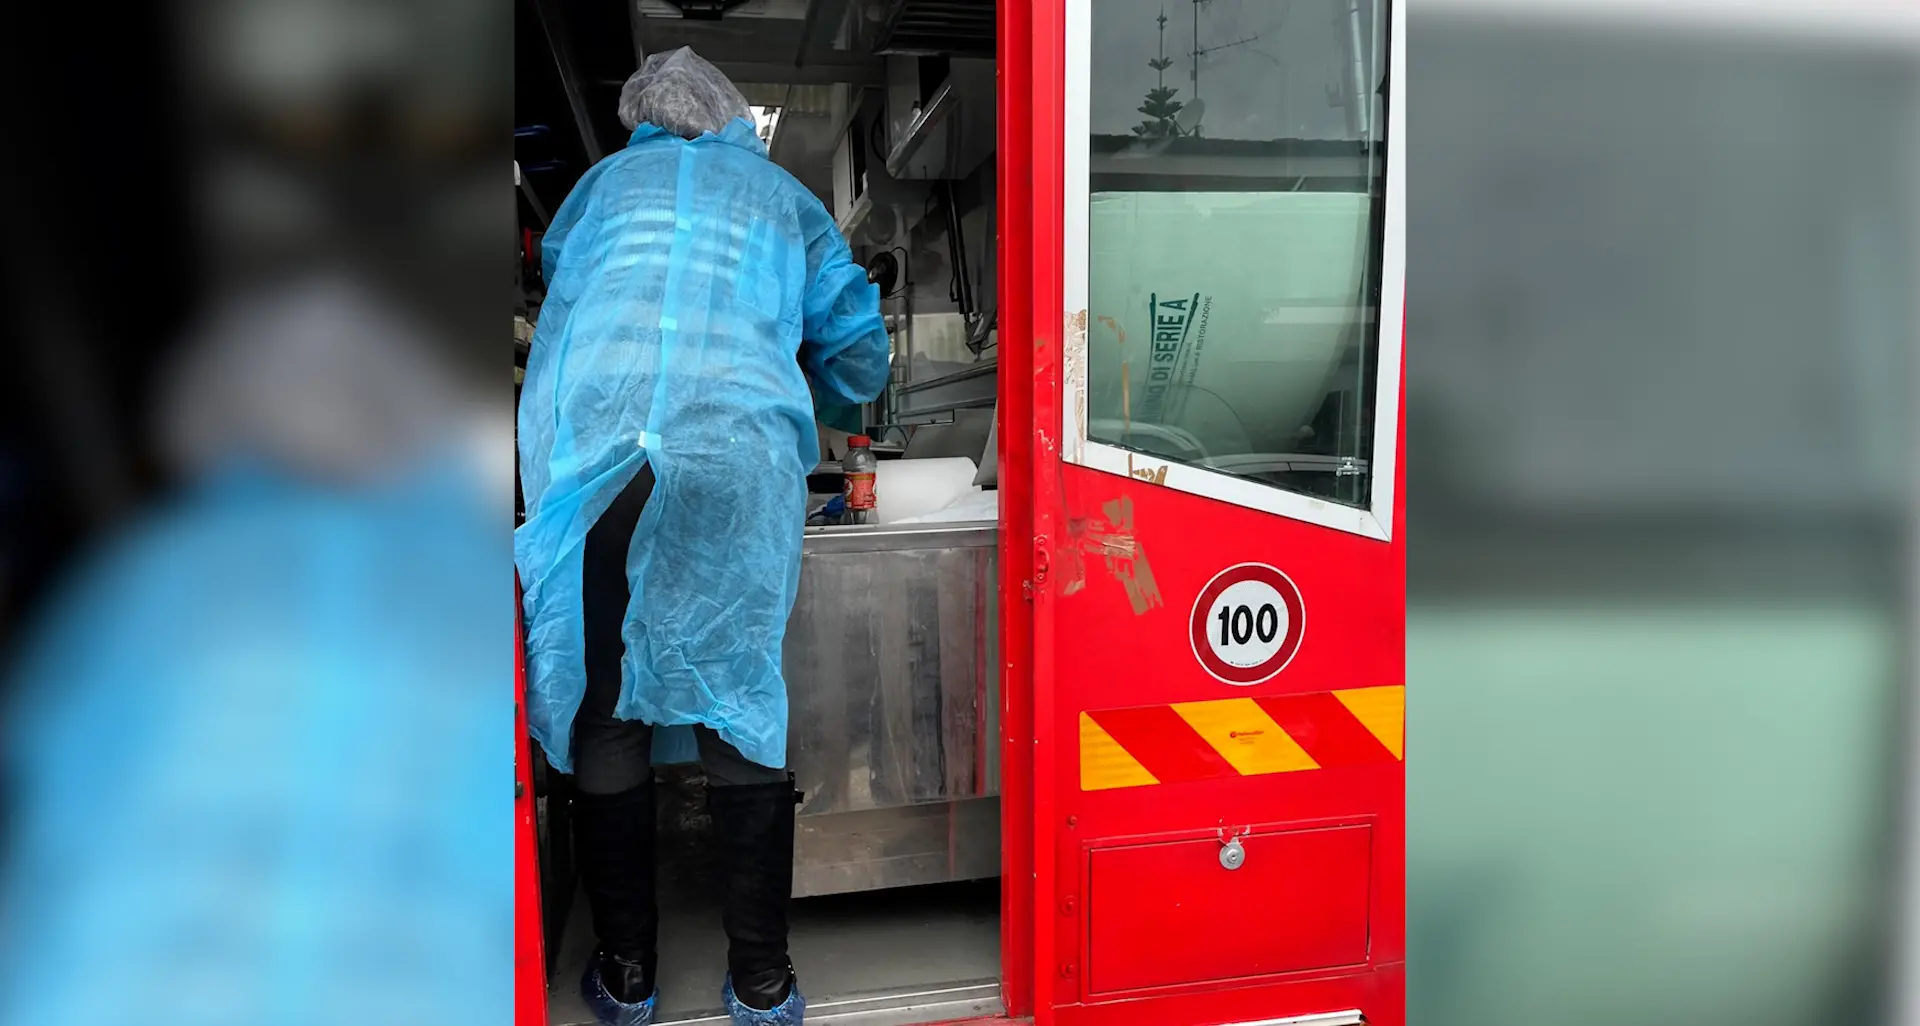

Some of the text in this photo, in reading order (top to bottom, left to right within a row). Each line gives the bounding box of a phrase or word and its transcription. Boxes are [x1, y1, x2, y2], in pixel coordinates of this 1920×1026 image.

[1159, 299, 1189, 311] A
[1196, 296, 1213, 351] RISTORAZIONE
[1154, 315, 1185, 363] SERIE
[1151, 366, 1171, 382] DI
[1218, 602, 1279, 646] 100
